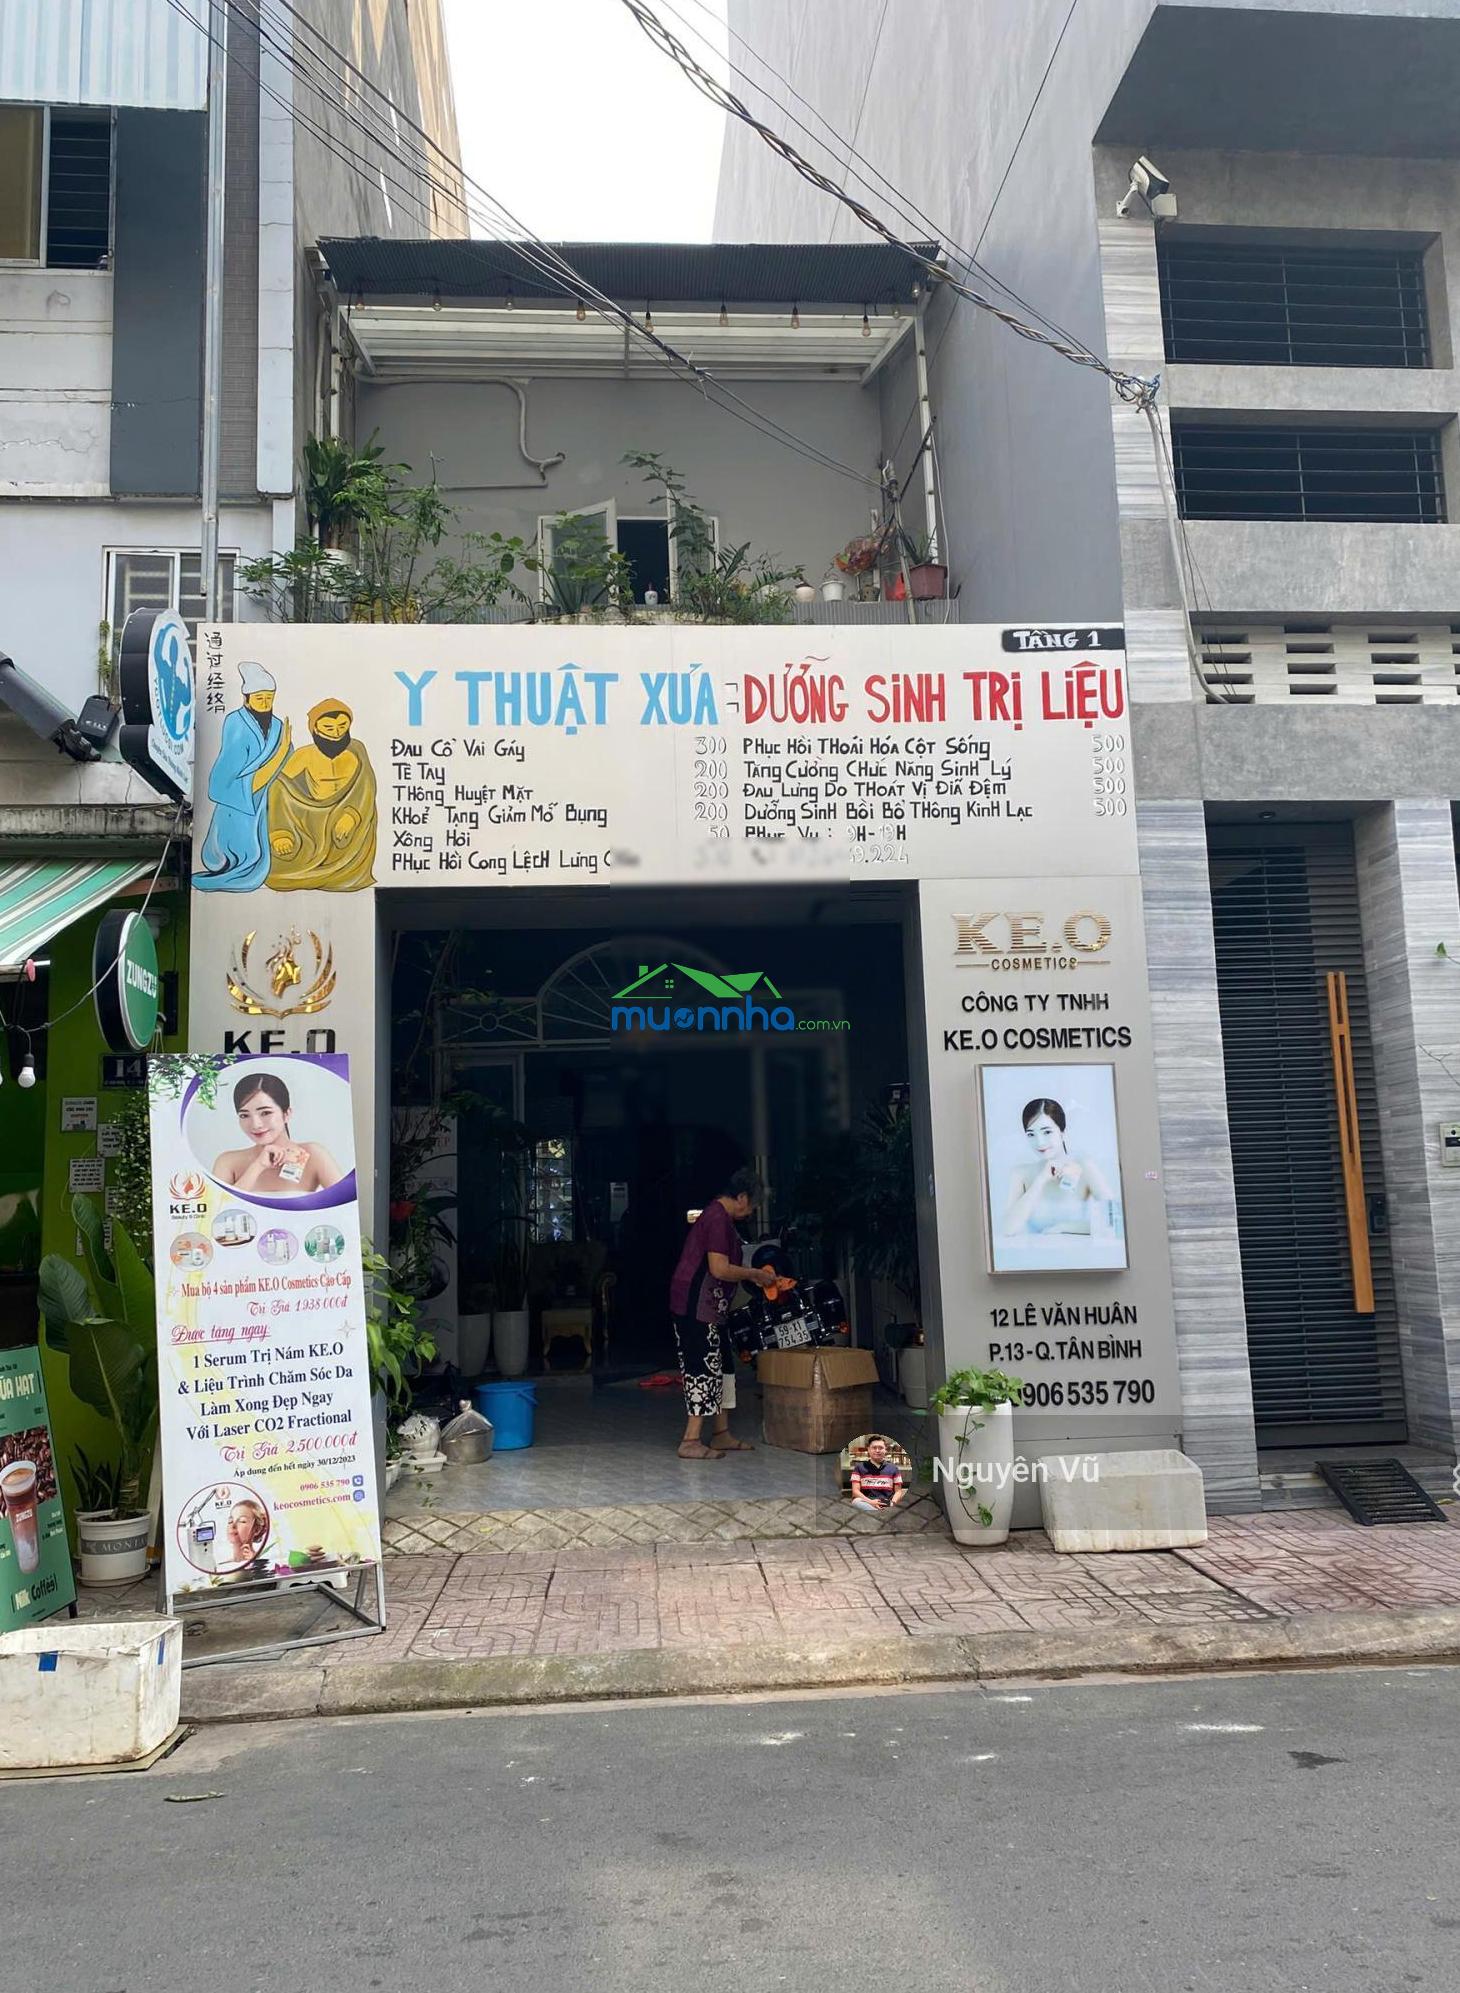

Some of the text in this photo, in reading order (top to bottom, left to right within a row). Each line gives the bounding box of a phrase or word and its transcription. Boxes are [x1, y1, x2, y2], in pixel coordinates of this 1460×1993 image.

[1013, 630, 1102, 650] TẦNG 1
[394, 671, 438, 726] Y
[455, 663, 619, 735] THUẬT
[694, 736, 727, 755] 300
[788, 735, 811, 755] Hồi
[946, 735, 990, 760] Sống
[1092, 734, 1125, 753] 500
[694, 760, 728, 779] 200
[991, 757, 1012, 780] Lý
[1093, 757, 1125, 775] 500
[694, 782, 729, 802] 200
[825, 782, 847, 797] Do
[912, 781, 927, 799] Vị
[1093, 777, 1126, 794] 500
[566, 804, 608, 828] Bụng
[694, 802, 729, 822] 200
[846, 799, 874, 819] Bồi
[1094, 798, 1127, 816] 500
[393, 830, 433, 852] Xông
[439, 850, 462, 870] Hồi
[468, 851, 507, 875] Cong
[951, 910, 1112, 954] KE.O
[991, 957, 1078, 971] COSMETICS
[961, 991, 1109, 1013] CÔNG TY TNHH
[944, 1026, 1132, 1051] KE.O COSMETICS
[115, 1059, 142, 1078] 14
[170, 1203, 207, 1214] KE.O
[182, 1269, 352, 1299] Mua bộ 4 sản phẩm KE.O Cosmetics Cao Cấp
[990, 1301, 1137, 1327] 12 LÊ VĂN HUÂN
[194, 1341, 344, 1368] 1 Serum Trị Nám KE.O
[1098, 1334, 1142, 1359] BÌNH
[178, 1365, 353, 1395] & Liệu Trình Chăm Sóc Da
[1068, 1381, 1108, 1405] 535
[1113, 1379, 1155, 1403] 790
[200, 1391, 333, 1417] Làm Xong Đẹp Ngay
[186, 1409, 352, 1440] Với Laser CO2 Fractional
[274, 1494, 351, 1511] keocosmetics.com
